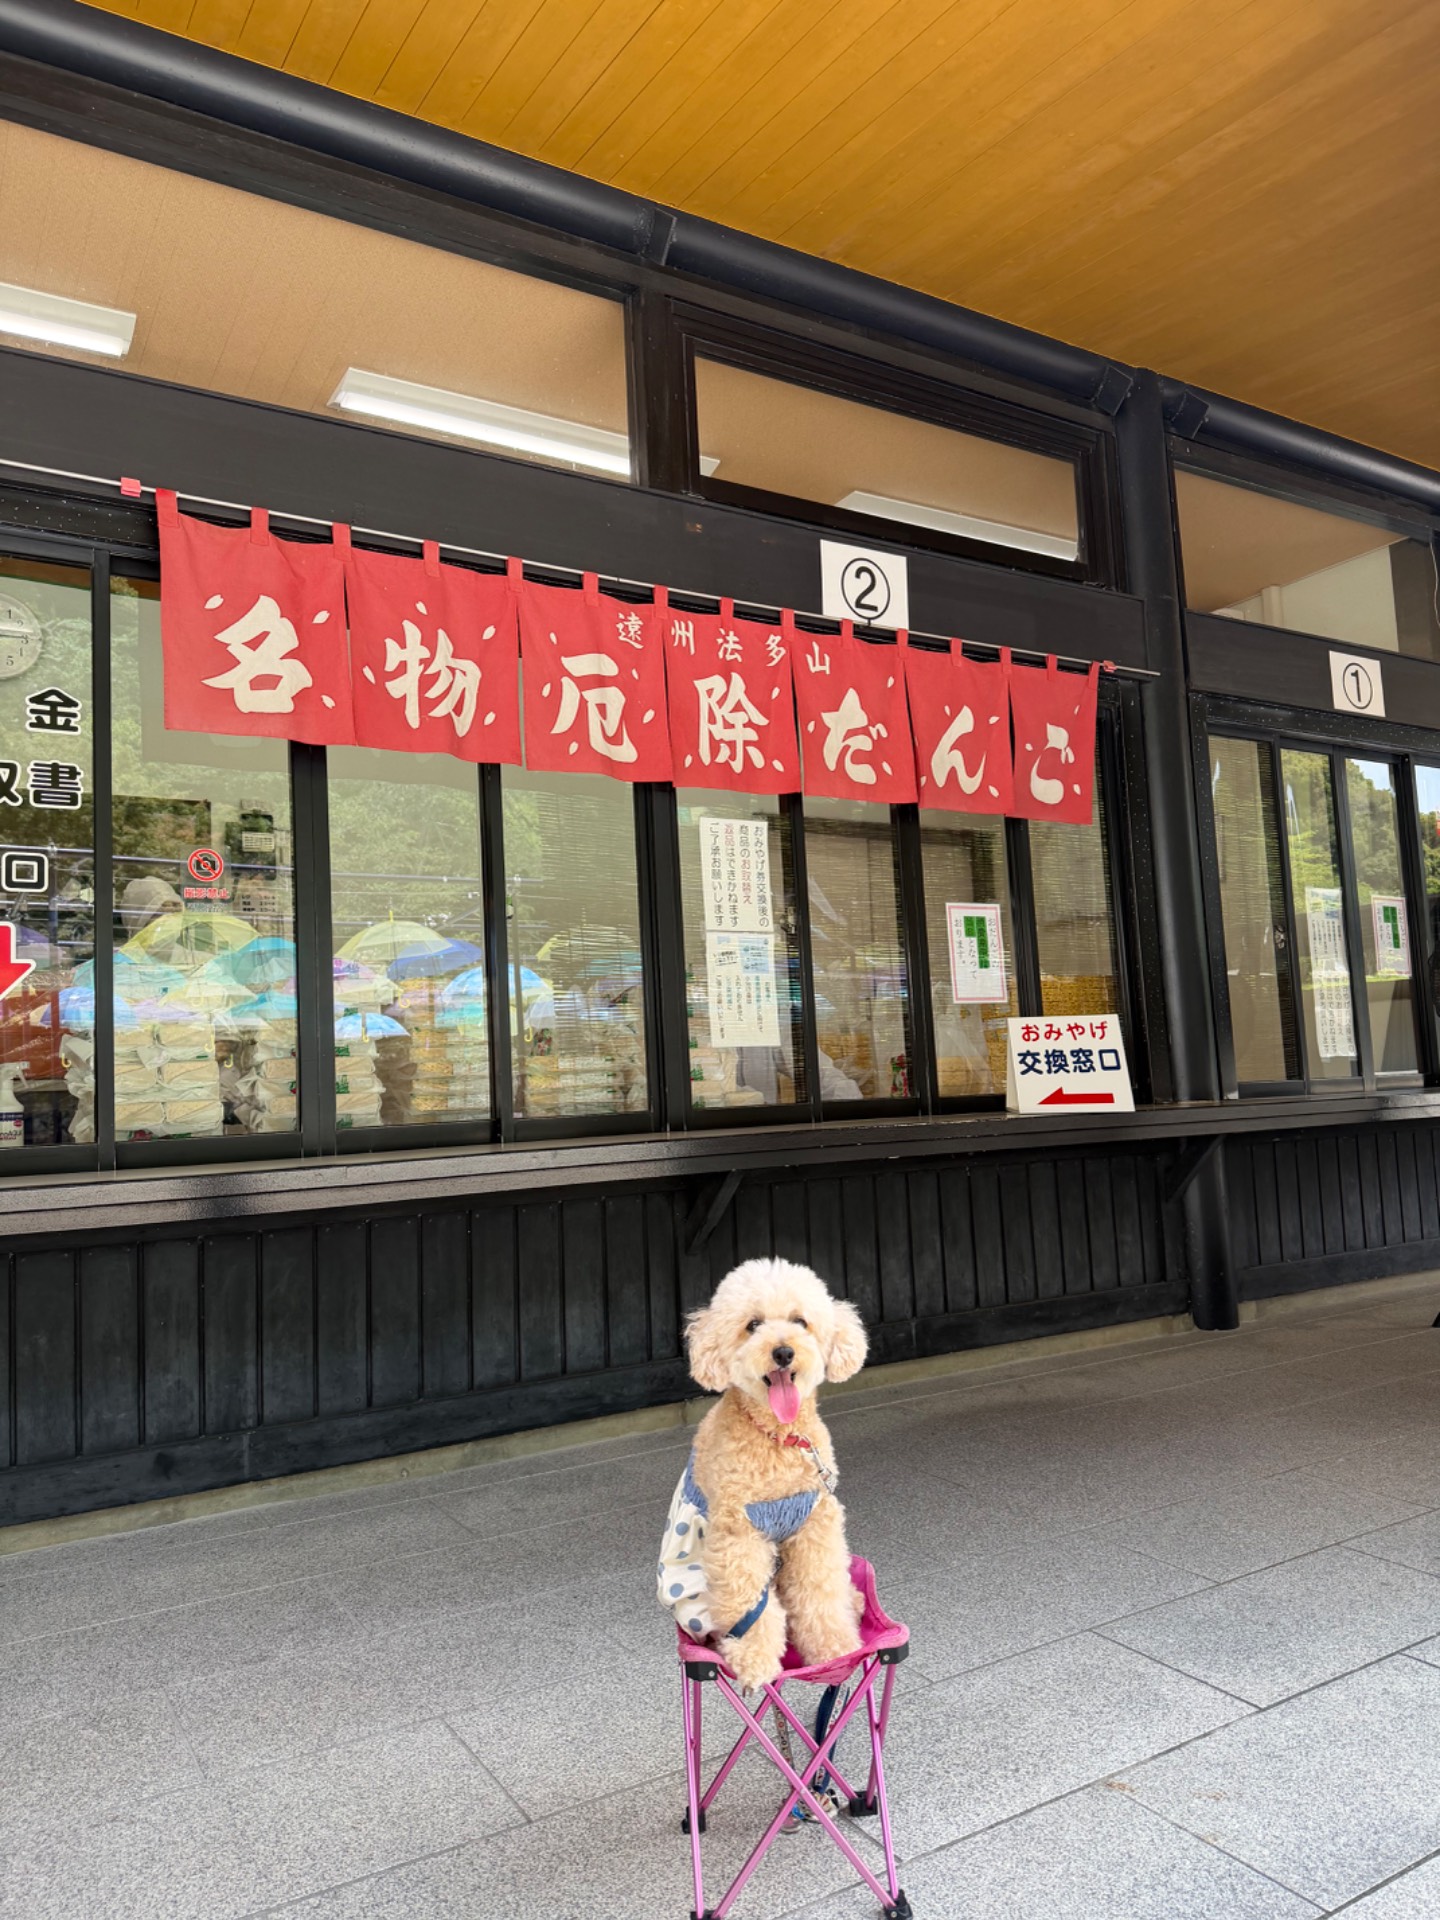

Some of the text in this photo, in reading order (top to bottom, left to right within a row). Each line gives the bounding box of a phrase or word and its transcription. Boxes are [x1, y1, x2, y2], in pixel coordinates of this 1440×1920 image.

[615, 612, 831, 677] 遠州法多山
[26, 687, 82, 735] 金
[709, 822, 724, 926] ご了承お願いします
[1020, 1020, 1108, 1042] おみやげ
[1017, 1048, 1122, 1076] 交換窓口
